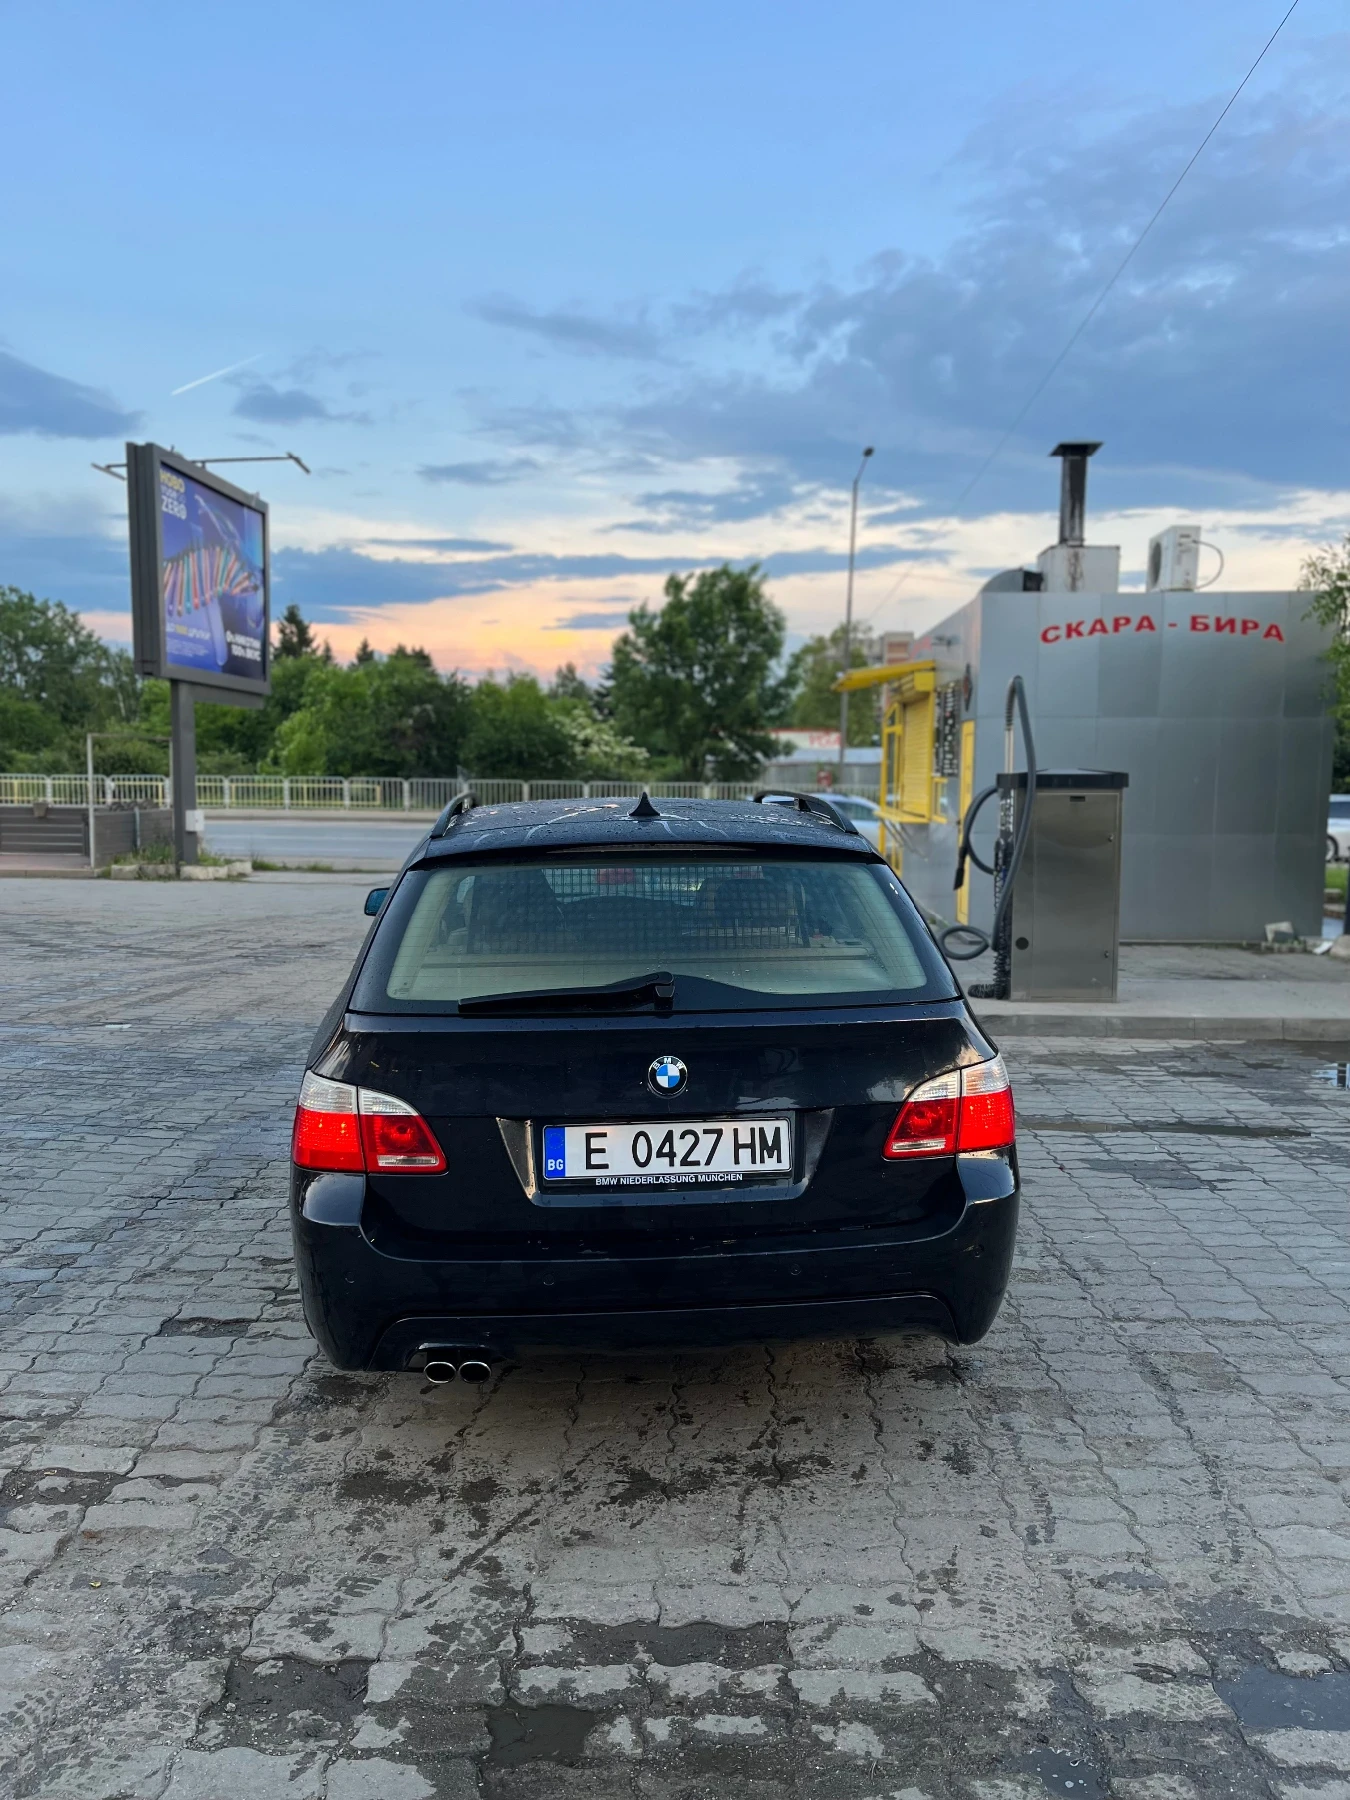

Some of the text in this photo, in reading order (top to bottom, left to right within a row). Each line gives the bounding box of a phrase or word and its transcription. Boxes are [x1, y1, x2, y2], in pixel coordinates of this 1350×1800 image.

[161, 492, 187, 520] ZERO
[1040, 615, 1156, 644] СКАРА
[1190, 615, 1285, 642] БИРА
[652, 1057, 684, 1070] BMW
[585, 1126, 782, 1170] E 0427 HM
[547, 1159, 564, 1171] BG
[595, 1177, 617, 1186] BMW
[620, 1175, 696, 1185] NIEDERLASSUNG
